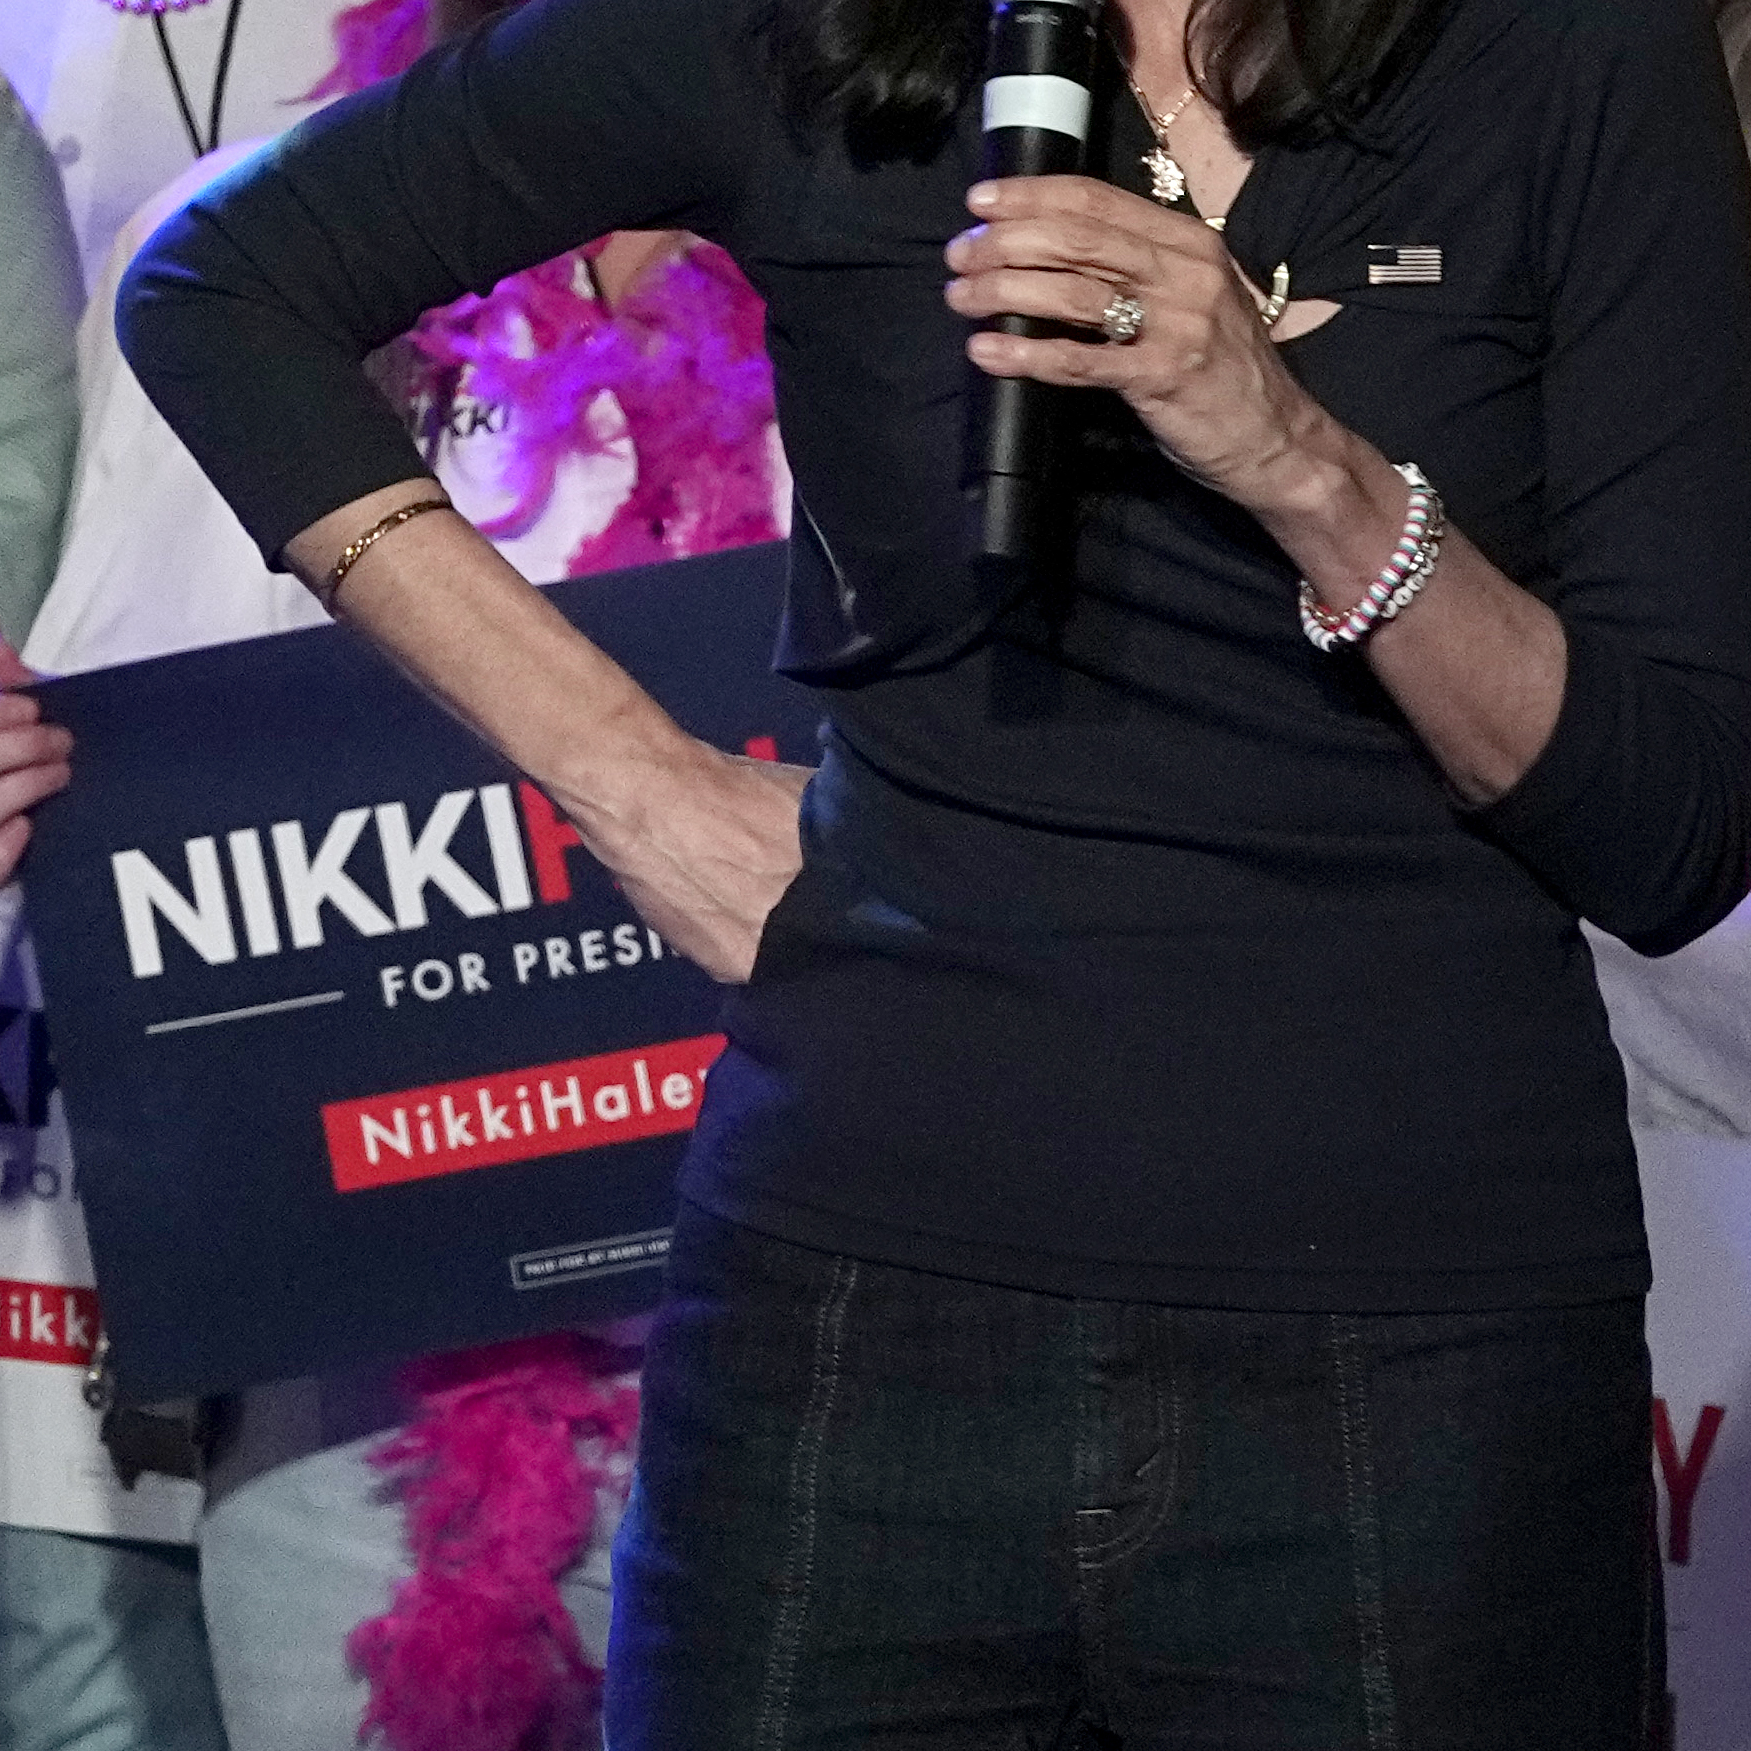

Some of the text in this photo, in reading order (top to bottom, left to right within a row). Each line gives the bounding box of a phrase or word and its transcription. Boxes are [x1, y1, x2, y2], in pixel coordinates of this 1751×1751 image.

[380, 923, 681, 1008] FOR PRESI
[360, 1058, 708, 1165] NikkiHale
